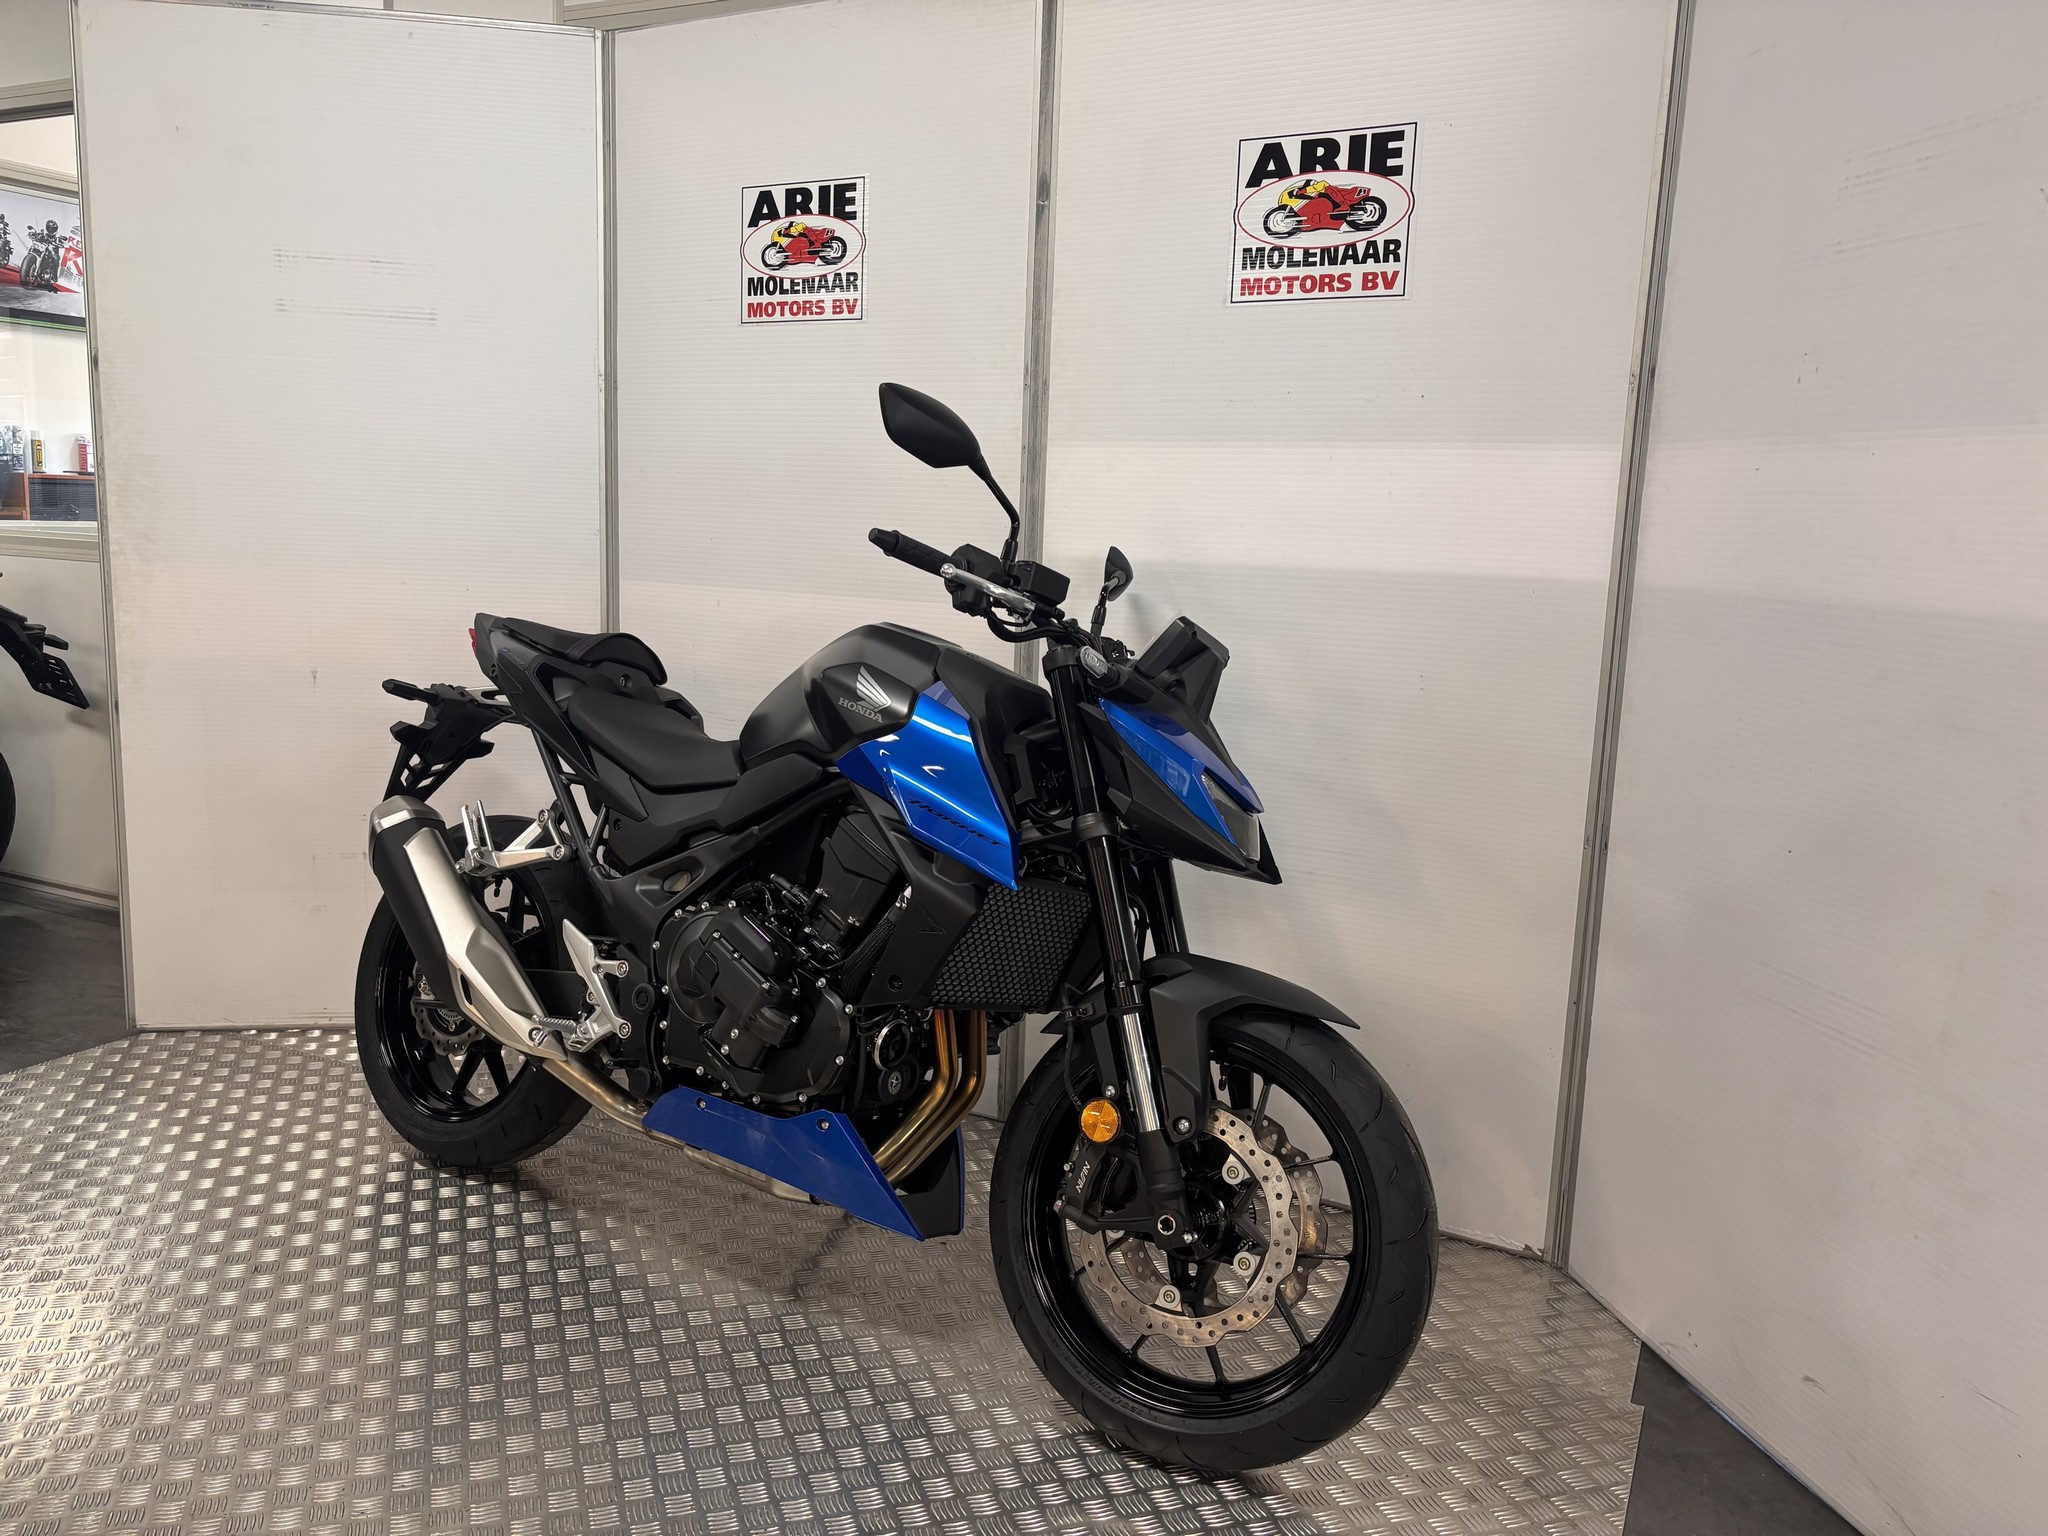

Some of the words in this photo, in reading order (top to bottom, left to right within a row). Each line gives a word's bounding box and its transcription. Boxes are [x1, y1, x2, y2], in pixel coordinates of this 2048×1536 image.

[1245, 130, 1405, 189] ARIE
[747, 182, 857, 228] ARIE
[1241, 238, 1401, 271] MOLENAAR
[747, 272, 859, 297] MOLENAAR
[1240, 272, 1352, 297] MOTORS
[1361, 270, 1401, 291] BV
[747, 300, 826, 318] MOTORS
[832, 298, 859, 316] BV
[837, 697, 883, 724] HONDA
